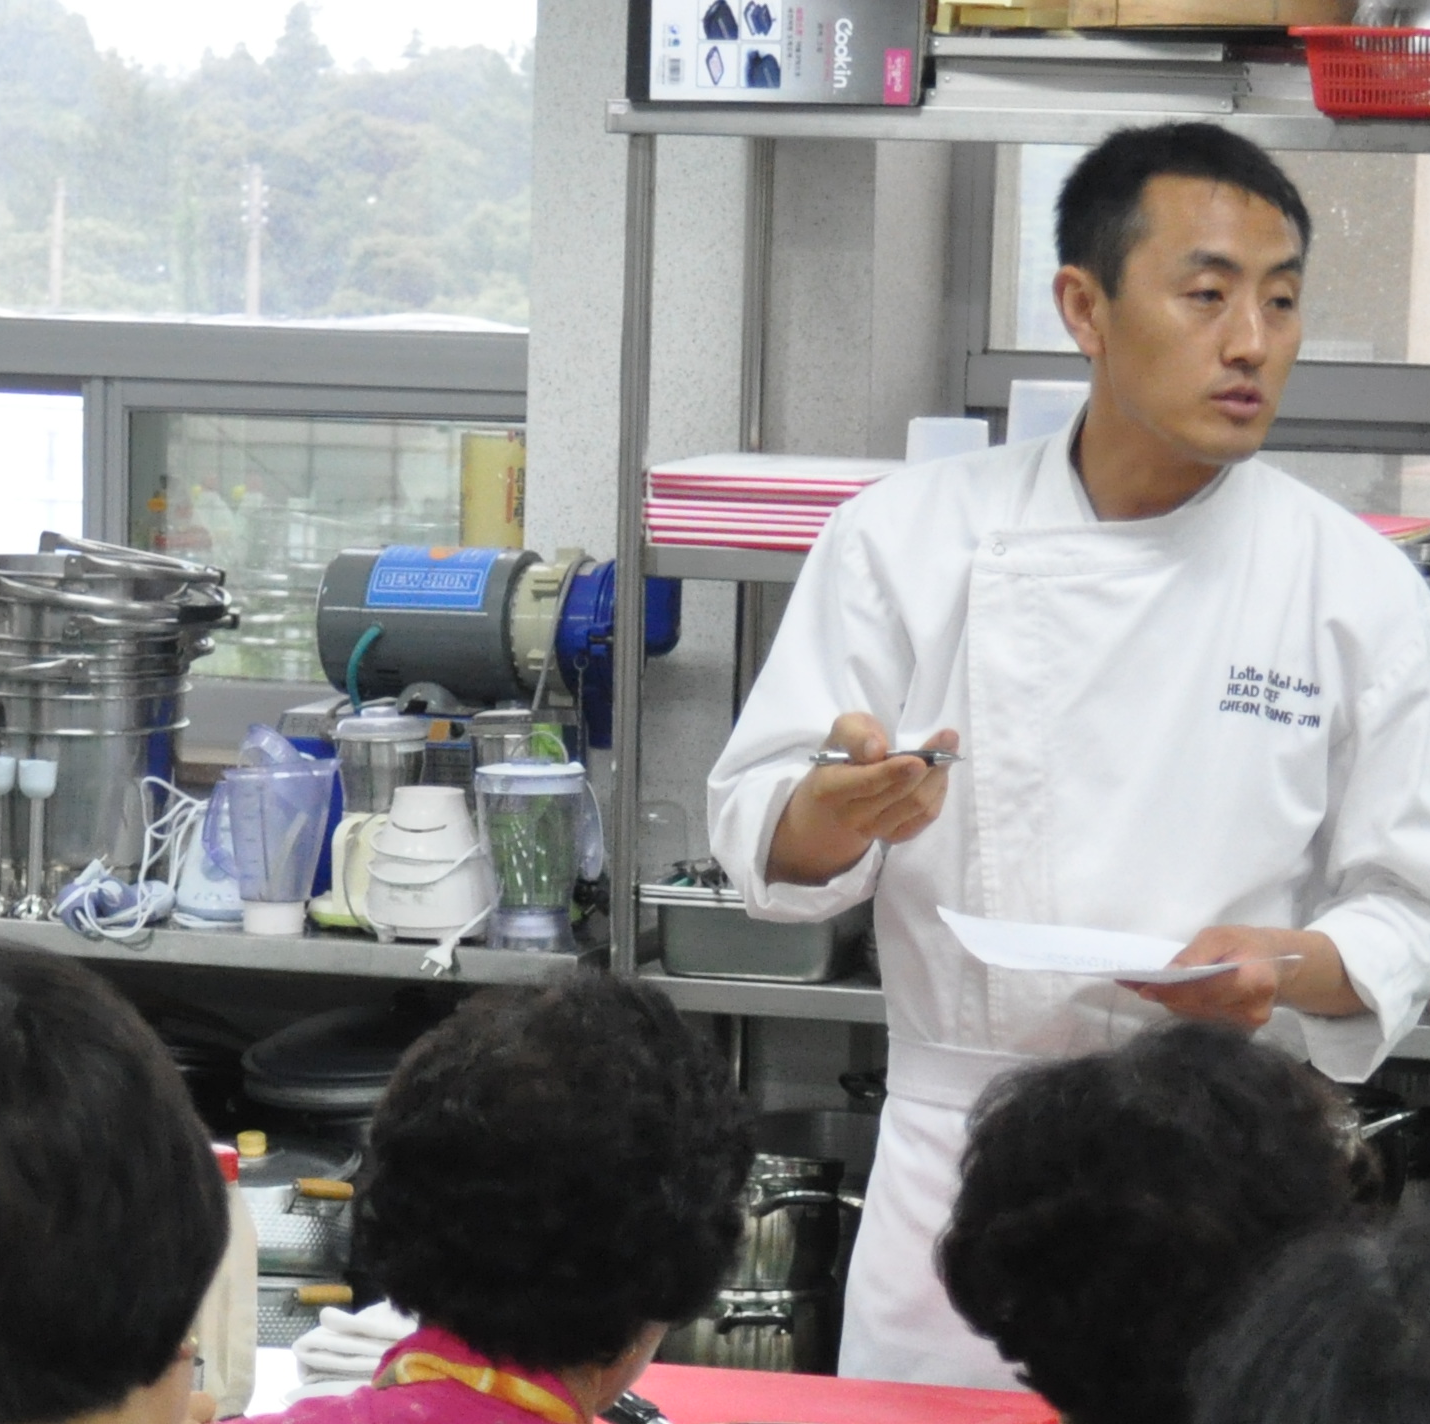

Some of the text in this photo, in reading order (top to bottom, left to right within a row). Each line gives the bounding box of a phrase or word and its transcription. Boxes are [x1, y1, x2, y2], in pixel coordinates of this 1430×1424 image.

[833, 17, 853, 88] Cookin
[1230, 665, 1264, 682] Lotte
[1227, 683, 1260, 698] HEAD
